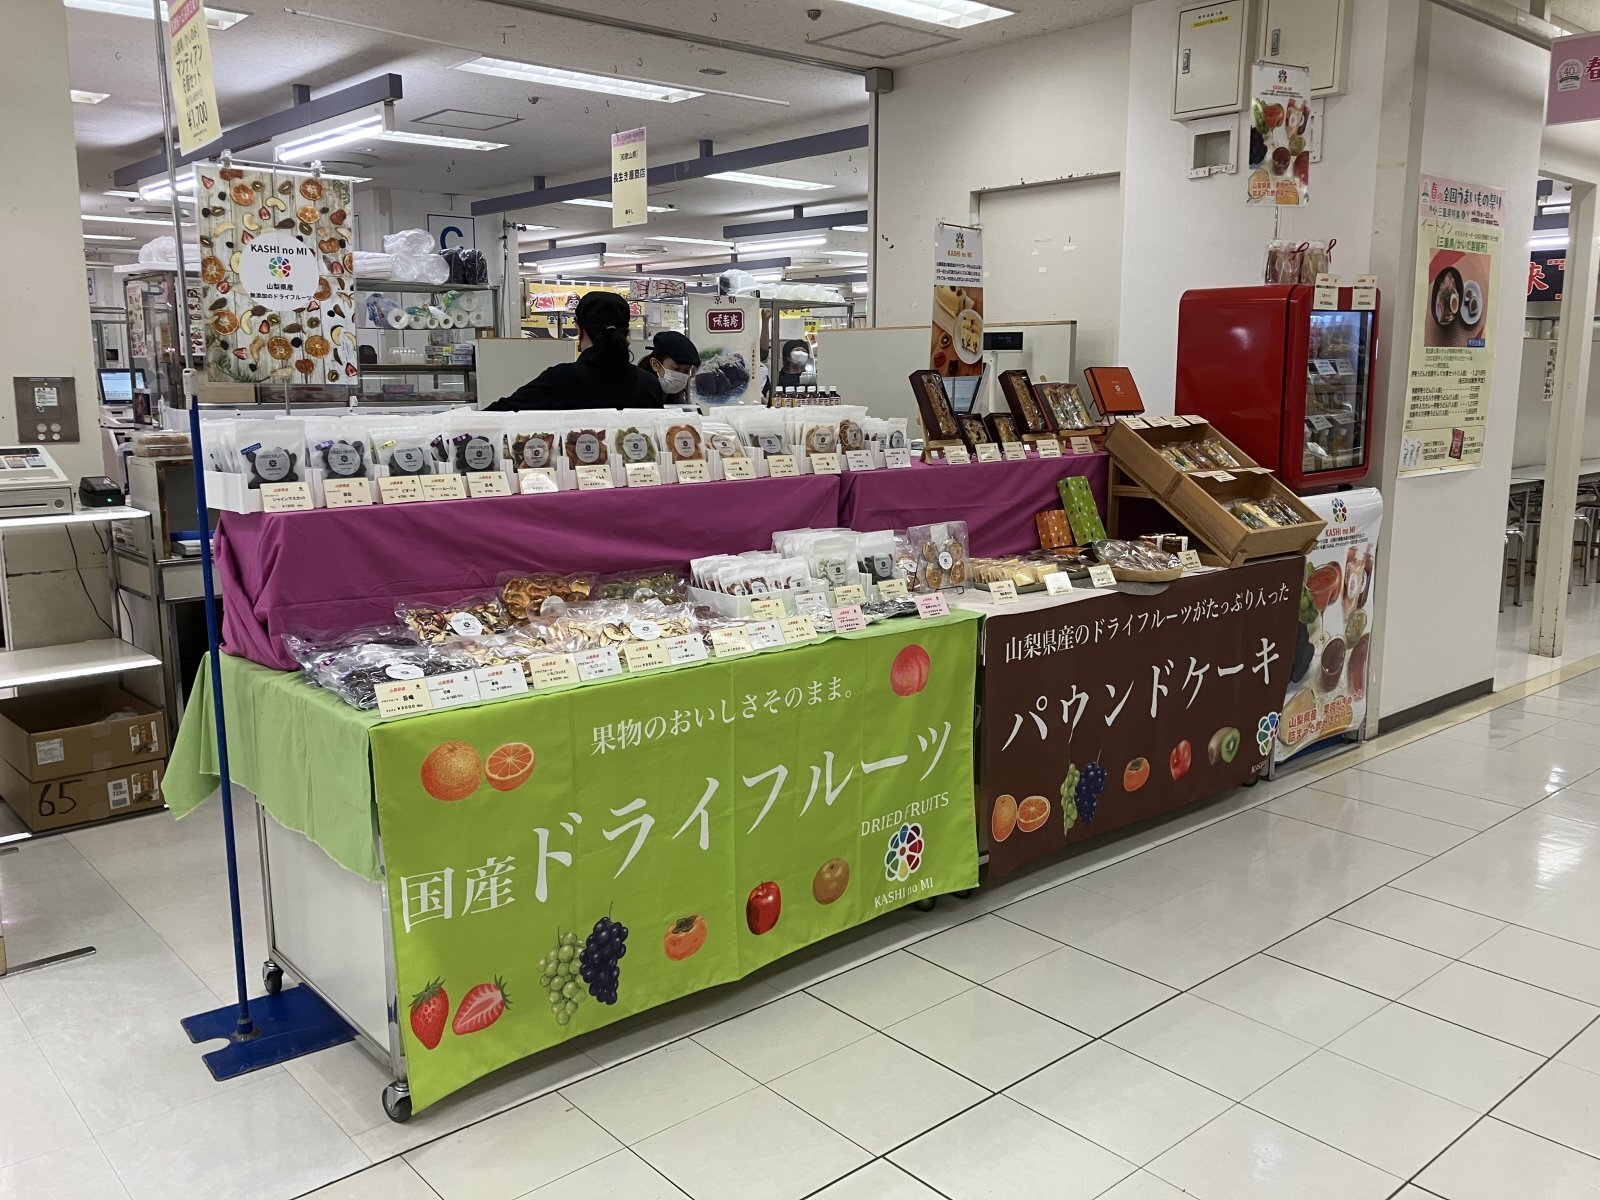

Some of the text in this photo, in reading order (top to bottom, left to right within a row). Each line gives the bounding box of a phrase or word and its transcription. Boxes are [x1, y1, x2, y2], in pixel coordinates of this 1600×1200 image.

[176, 44, 203, 77] マンディアン
[613, 168, 646, 184] 長生き屋商店
[1421, 218, 1453, 235] イートイン
[250, 244, 280, 254] KASHI
[296, 247, 307, 256] MI
[250, 292, 312, 301] 無添加のドライフルーツ
[266, 283, 294, 291] 山梨県産
[1325, 527, 1342, 537] KASHI
[1349, 525, 1356, 534] MI
[1005, 582, 1290, 664] 山梨県産のドライフルーツがたっぷり入った
[1001, 637, 1281, 752] パウンドケーキ
[591, 676, 852, 757] 果物のおいしさそのまま。
[1288, 708, 1318, 729] 山梨県産
[38, 778, 84, 817] 65
[399, 721, 951, 934] 国産ドライフルーツ
[861, 791, 949, 837] DRIED FRUITS
[874, 877, 934, 909] KASHI no MI
